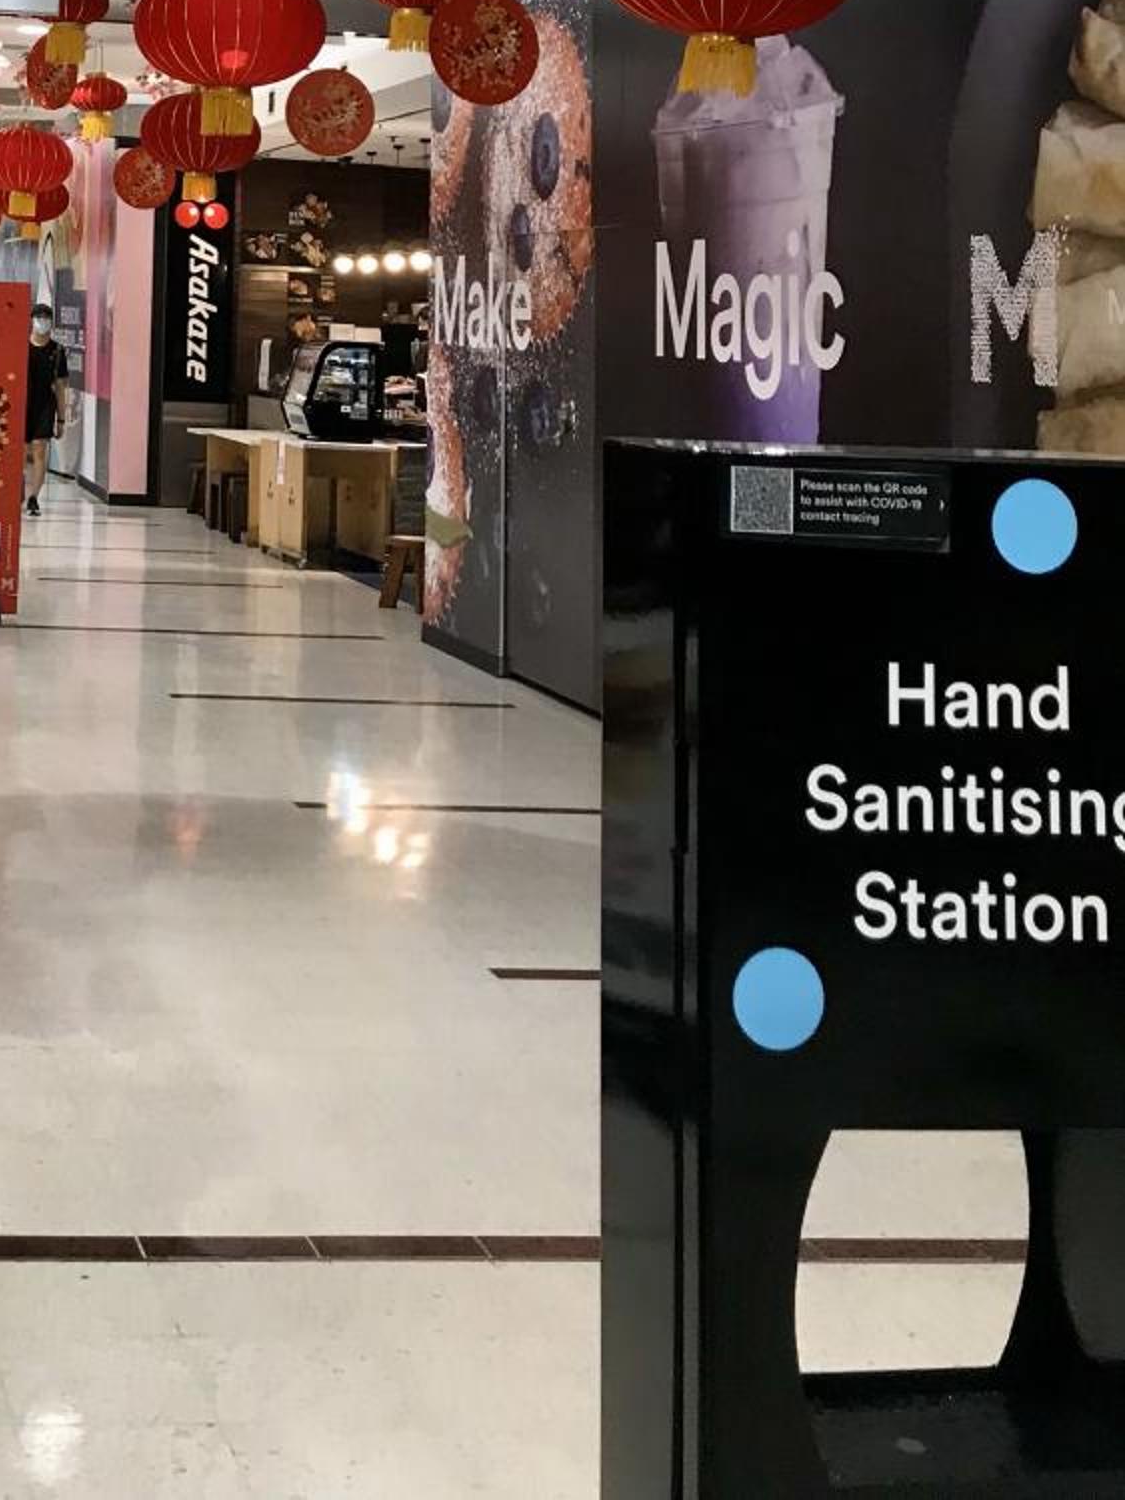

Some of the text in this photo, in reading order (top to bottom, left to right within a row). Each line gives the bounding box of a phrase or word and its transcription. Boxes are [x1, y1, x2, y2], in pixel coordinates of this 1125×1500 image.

[186, 233, 220, 383] Asakaze
[434, 238, 846, 400] Make Magic
[970, 231, 1060, 387] M
[800, 478, 929, 496] Please scan the QR code
[800, 495, 922, 511] to assist with COVID-19
[800, 510, 880, 526] contact tracing
[888, 661, 1070, 731] Hand
[853, 870, 1109, 942] Station
